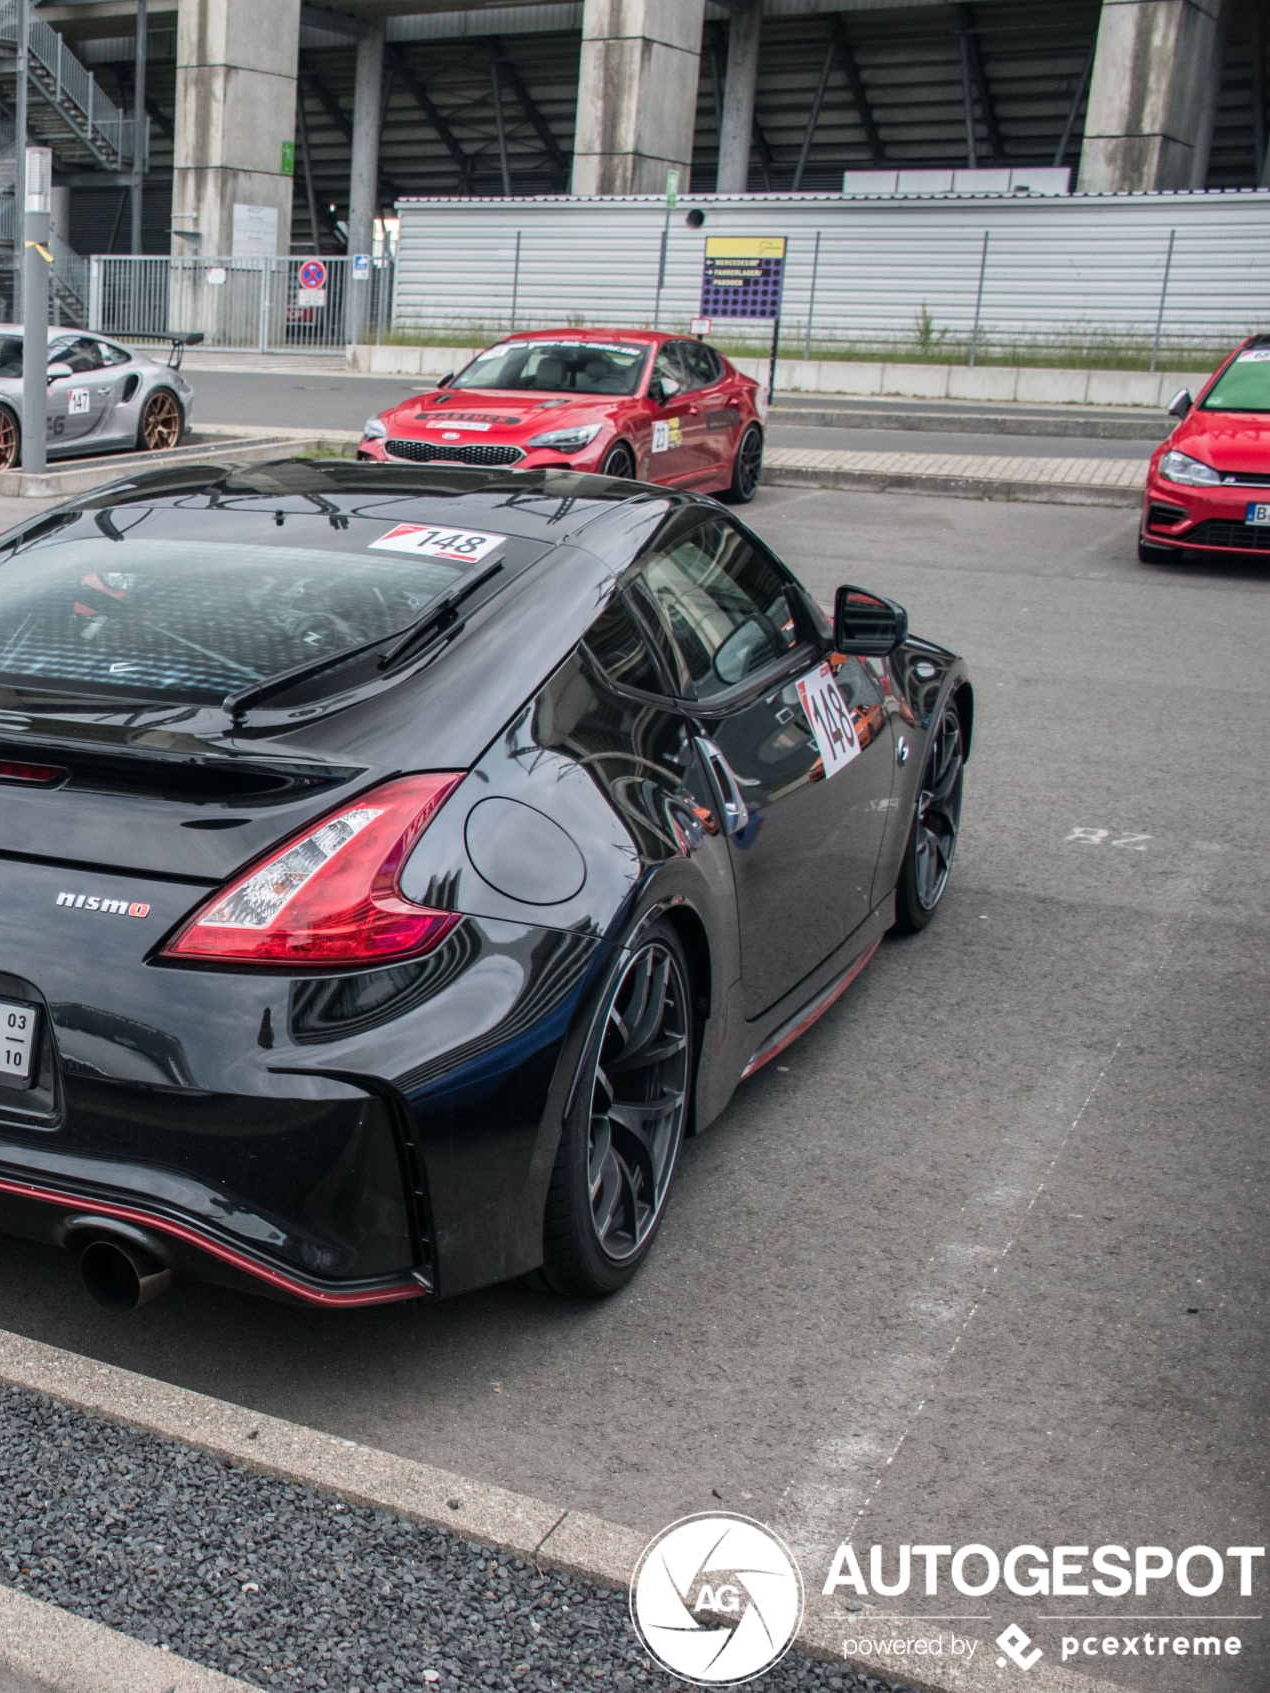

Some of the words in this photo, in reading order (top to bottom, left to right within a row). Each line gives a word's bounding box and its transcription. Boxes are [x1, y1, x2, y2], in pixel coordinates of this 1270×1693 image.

[712, 278, 744, 287] PADDOCK
[72, 393, 88, 411] 147
[655, 428, 666, 449] 23
[417, 531, 487, 553] 148
[811, 684, 855, 761] 148
[7, 1012, 28, 1030] 03
[4, 1049, 22, 1067] 10
